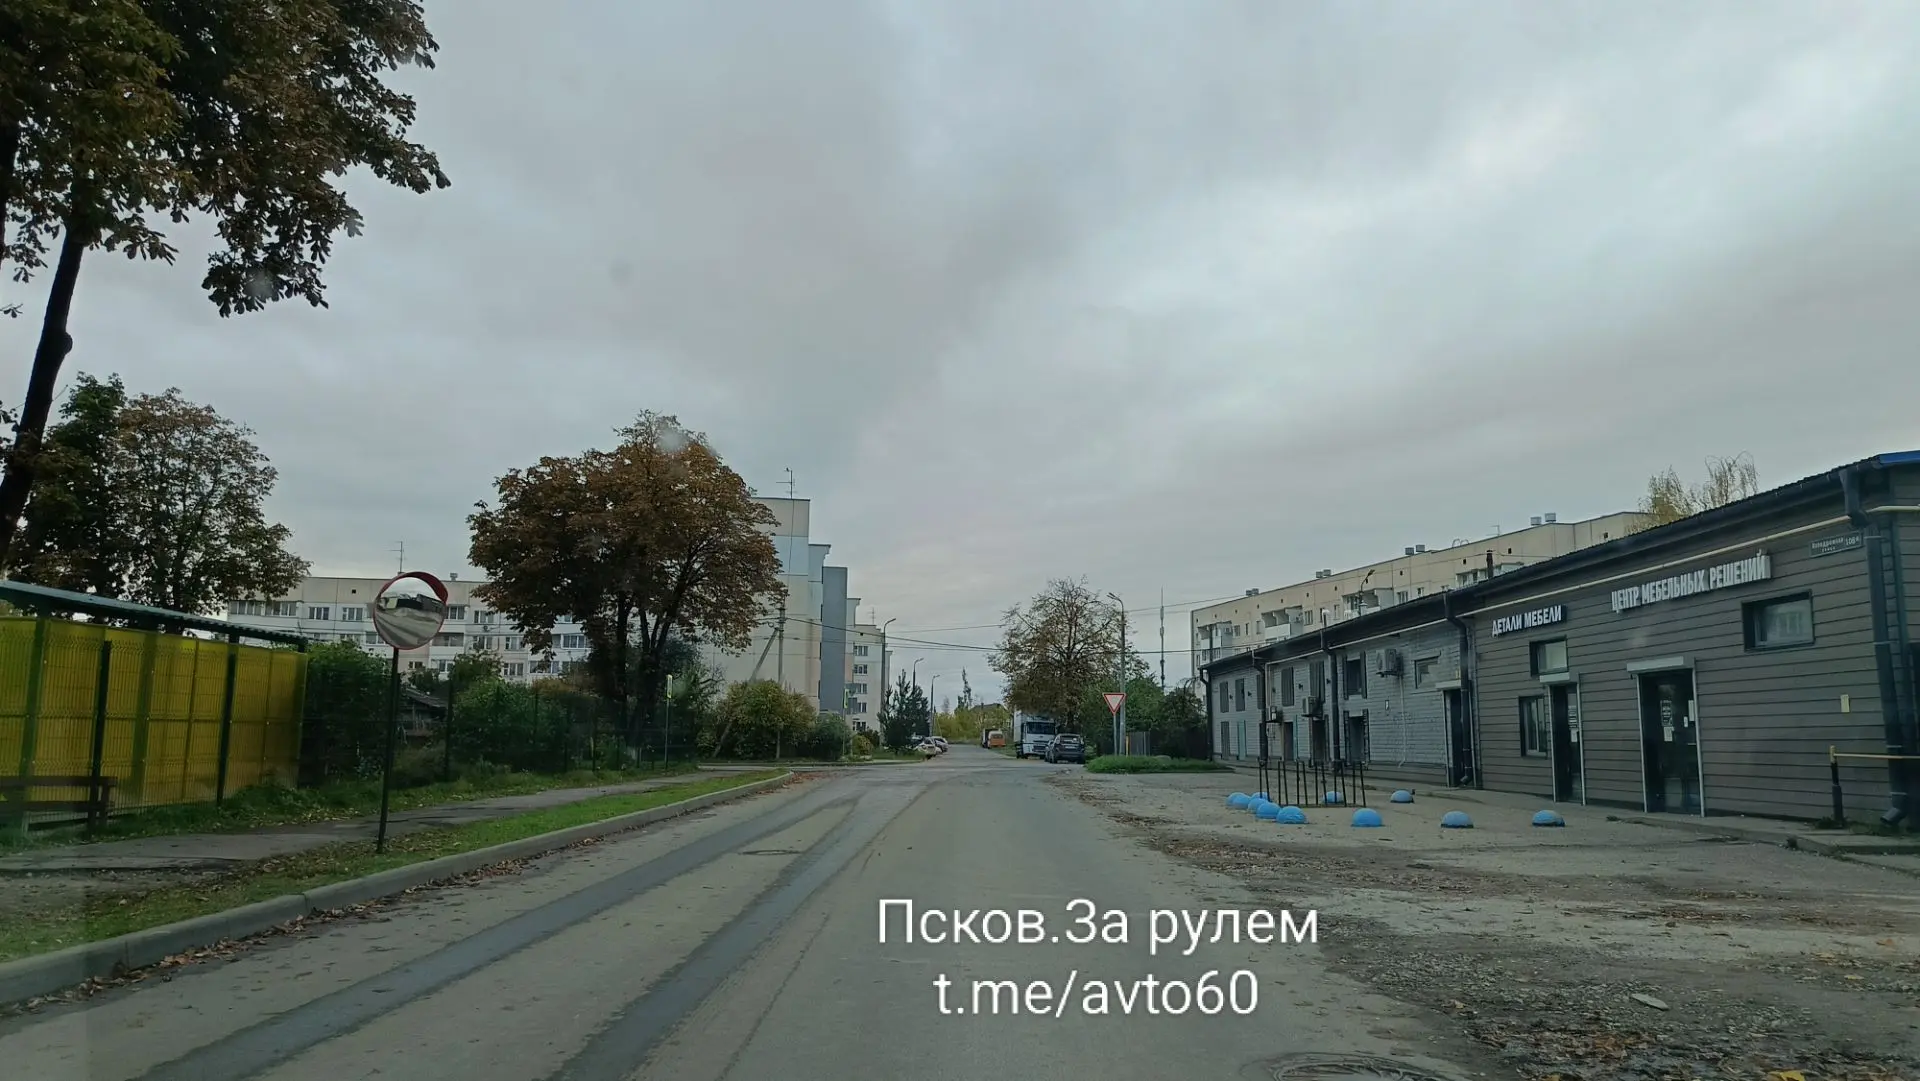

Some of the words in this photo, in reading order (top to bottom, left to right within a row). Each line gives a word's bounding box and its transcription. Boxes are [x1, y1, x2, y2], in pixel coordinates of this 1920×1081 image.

[1611, 586, 1641, 614] ЦЕНТР
[1641, 569, 1709, 605] МЕБЕЛЬНЫХ
[1709, 548, 1771, 590] РЕШЕНИЙ
[1492, 613, 1522, 638] ДЕТАЛИ
[1524, 605, 1561, 628] МЕБЕЛИ
